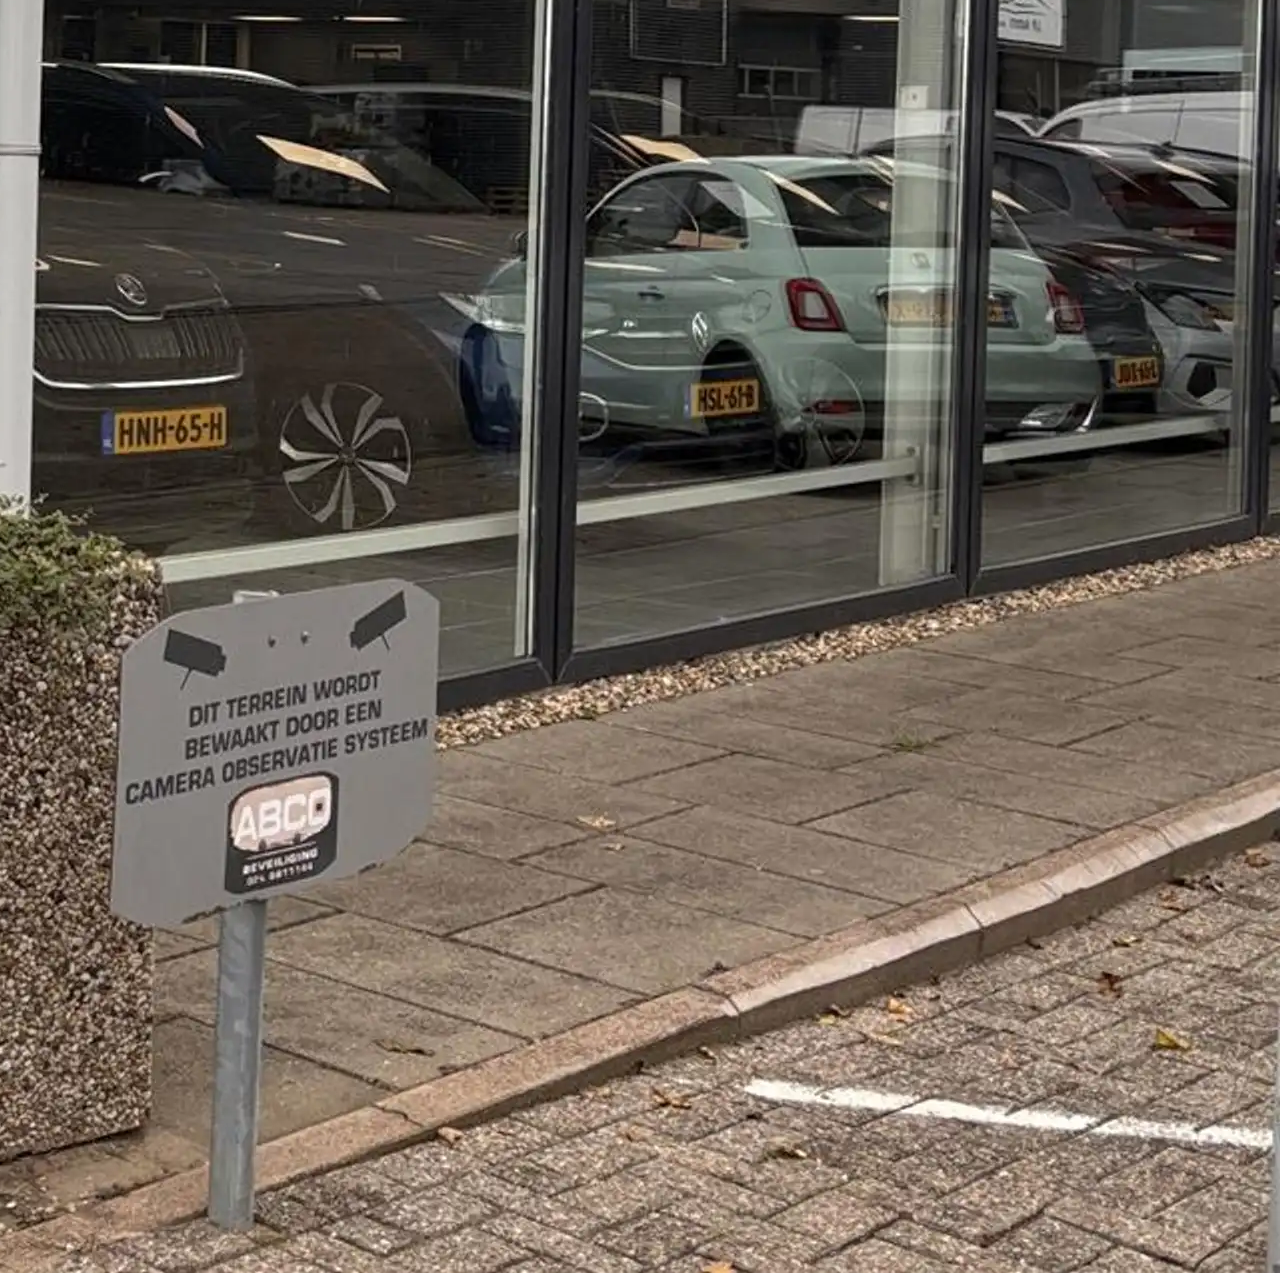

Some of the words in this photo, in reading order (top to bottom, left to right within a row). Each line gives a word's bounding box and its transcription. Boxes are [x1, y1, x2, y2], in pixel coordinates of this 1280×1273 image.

[119, 411, 223, 448] HNH-65-H
[189, 701, 221, 728] DIT
[226, 683, 307, 720] TERREIN
[313, 670, 382, 701] WORDT
[184, 721, 279, 760] BEWAAKT
[286, 708, 339, 737] DOOR
[345, 700, 382, 725] EEN
[125, 766, 215, 805] CAMERA
[222, 738, 338, 784] OBSERVATIE
[344, 718, 428, 755] SYSTEEM
